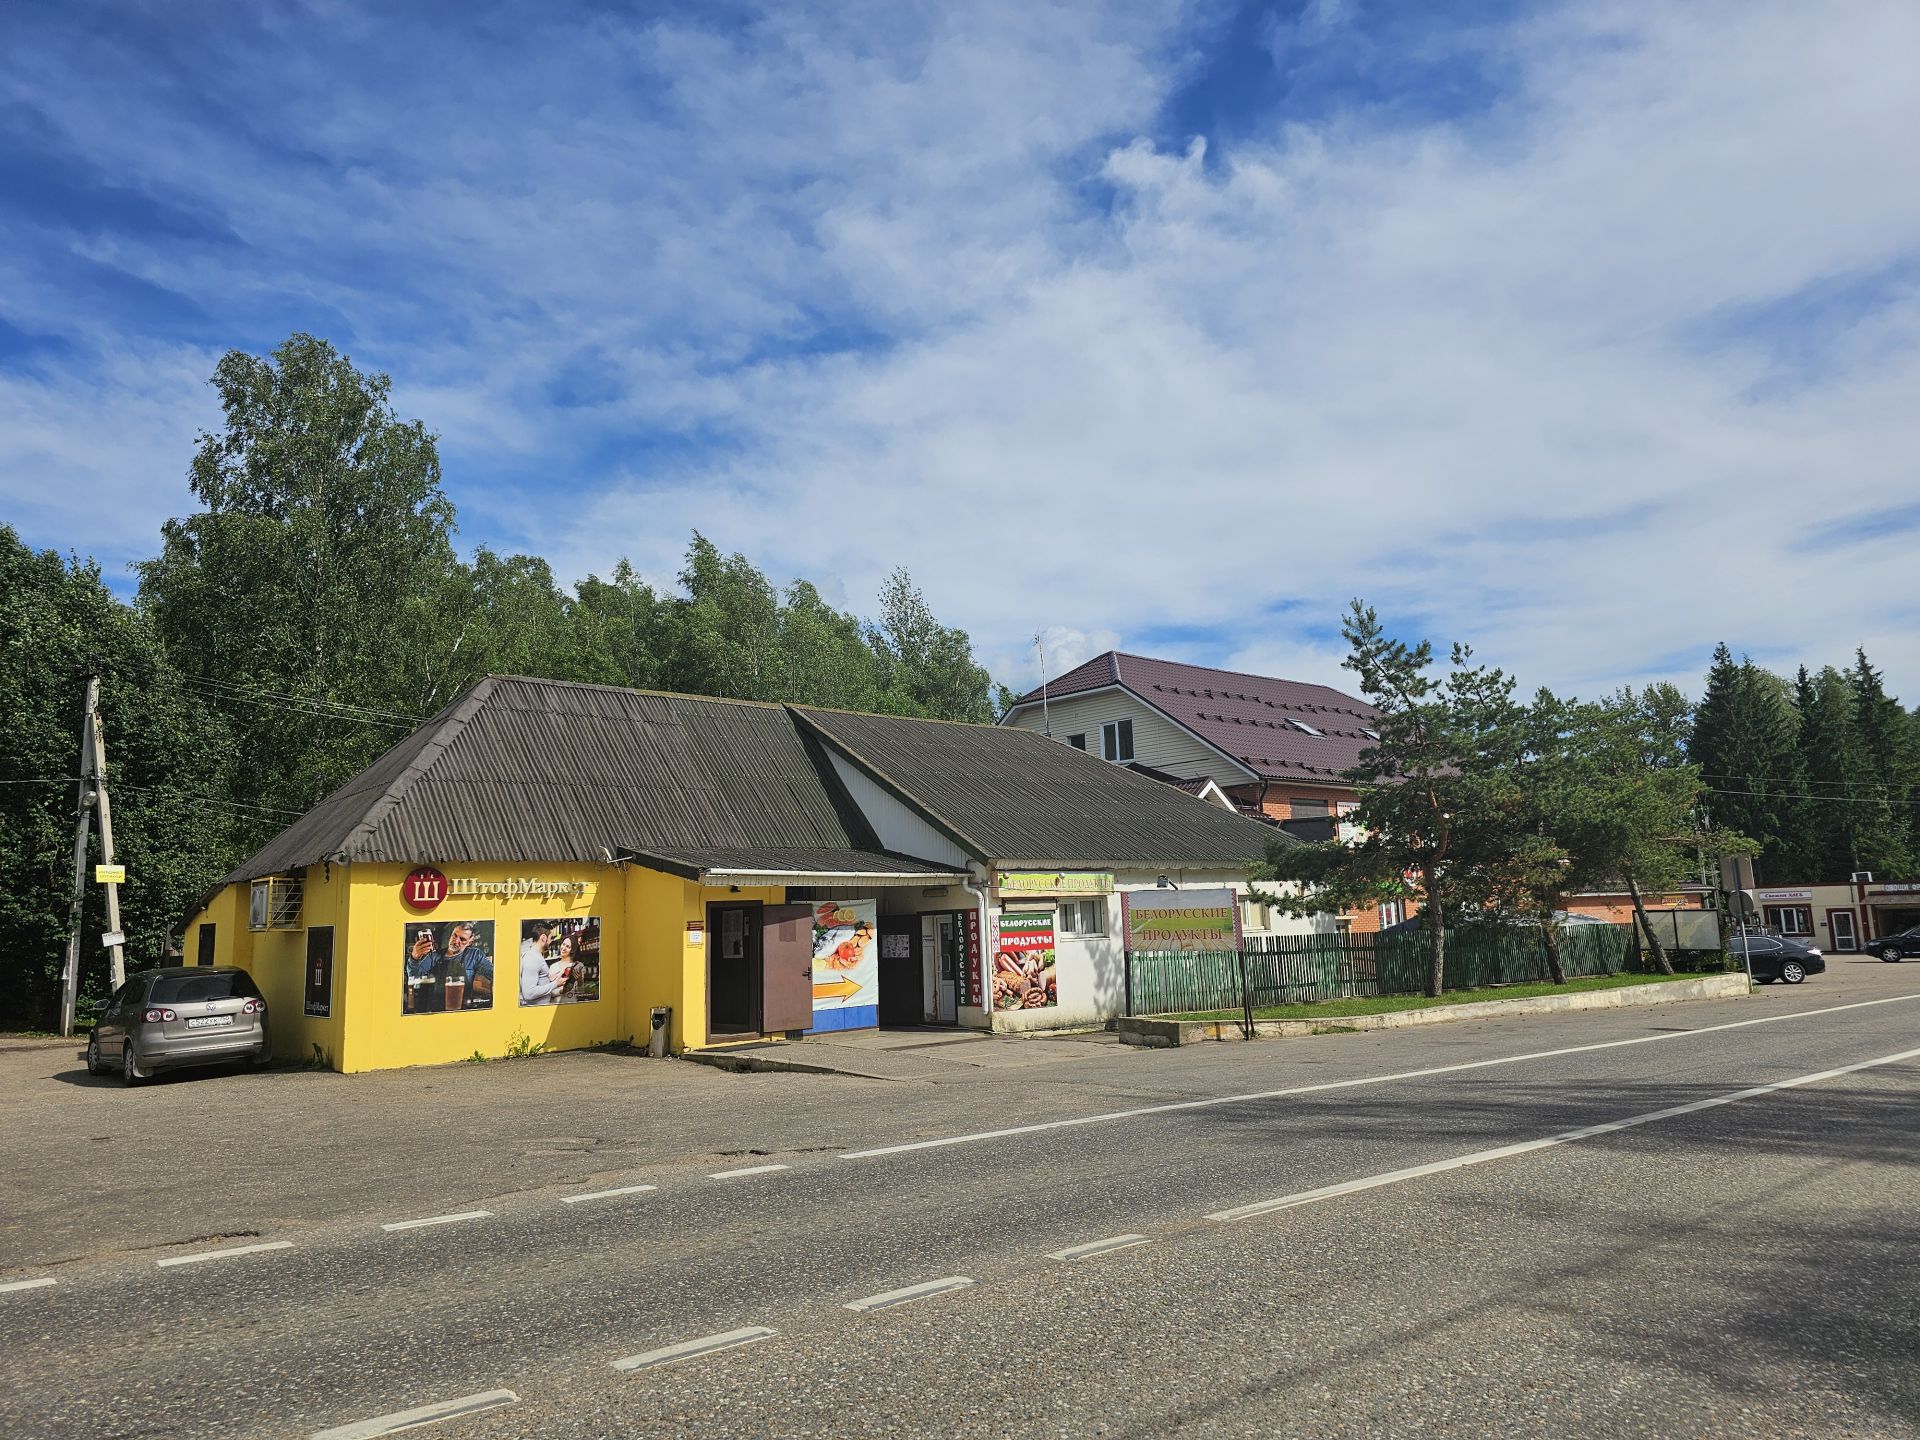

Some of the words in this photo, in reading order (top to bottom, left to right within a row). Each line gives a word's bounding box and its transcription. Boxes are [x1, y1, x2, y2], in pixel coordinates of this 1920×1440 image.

[451, 877, 588, 898] ШтофМаркет
[1067, 878, 1113, 889] ПРОДУКТЫ
[1135, 908, 1228, 919] БЕЛОРУССКИЕ
[1000, 918, 1052, 928] БЕЛОРУССКИЕ
[1142, 928, 1223, 940] ПРОДУКТЫ
[1001, 935, 1053, 946] ПРОДУКТЫ
[957, 913, 966, 1004] БЕЛОРУССКИЕ
[969, 911, 982, 1004] ПРОДУКТЫ
